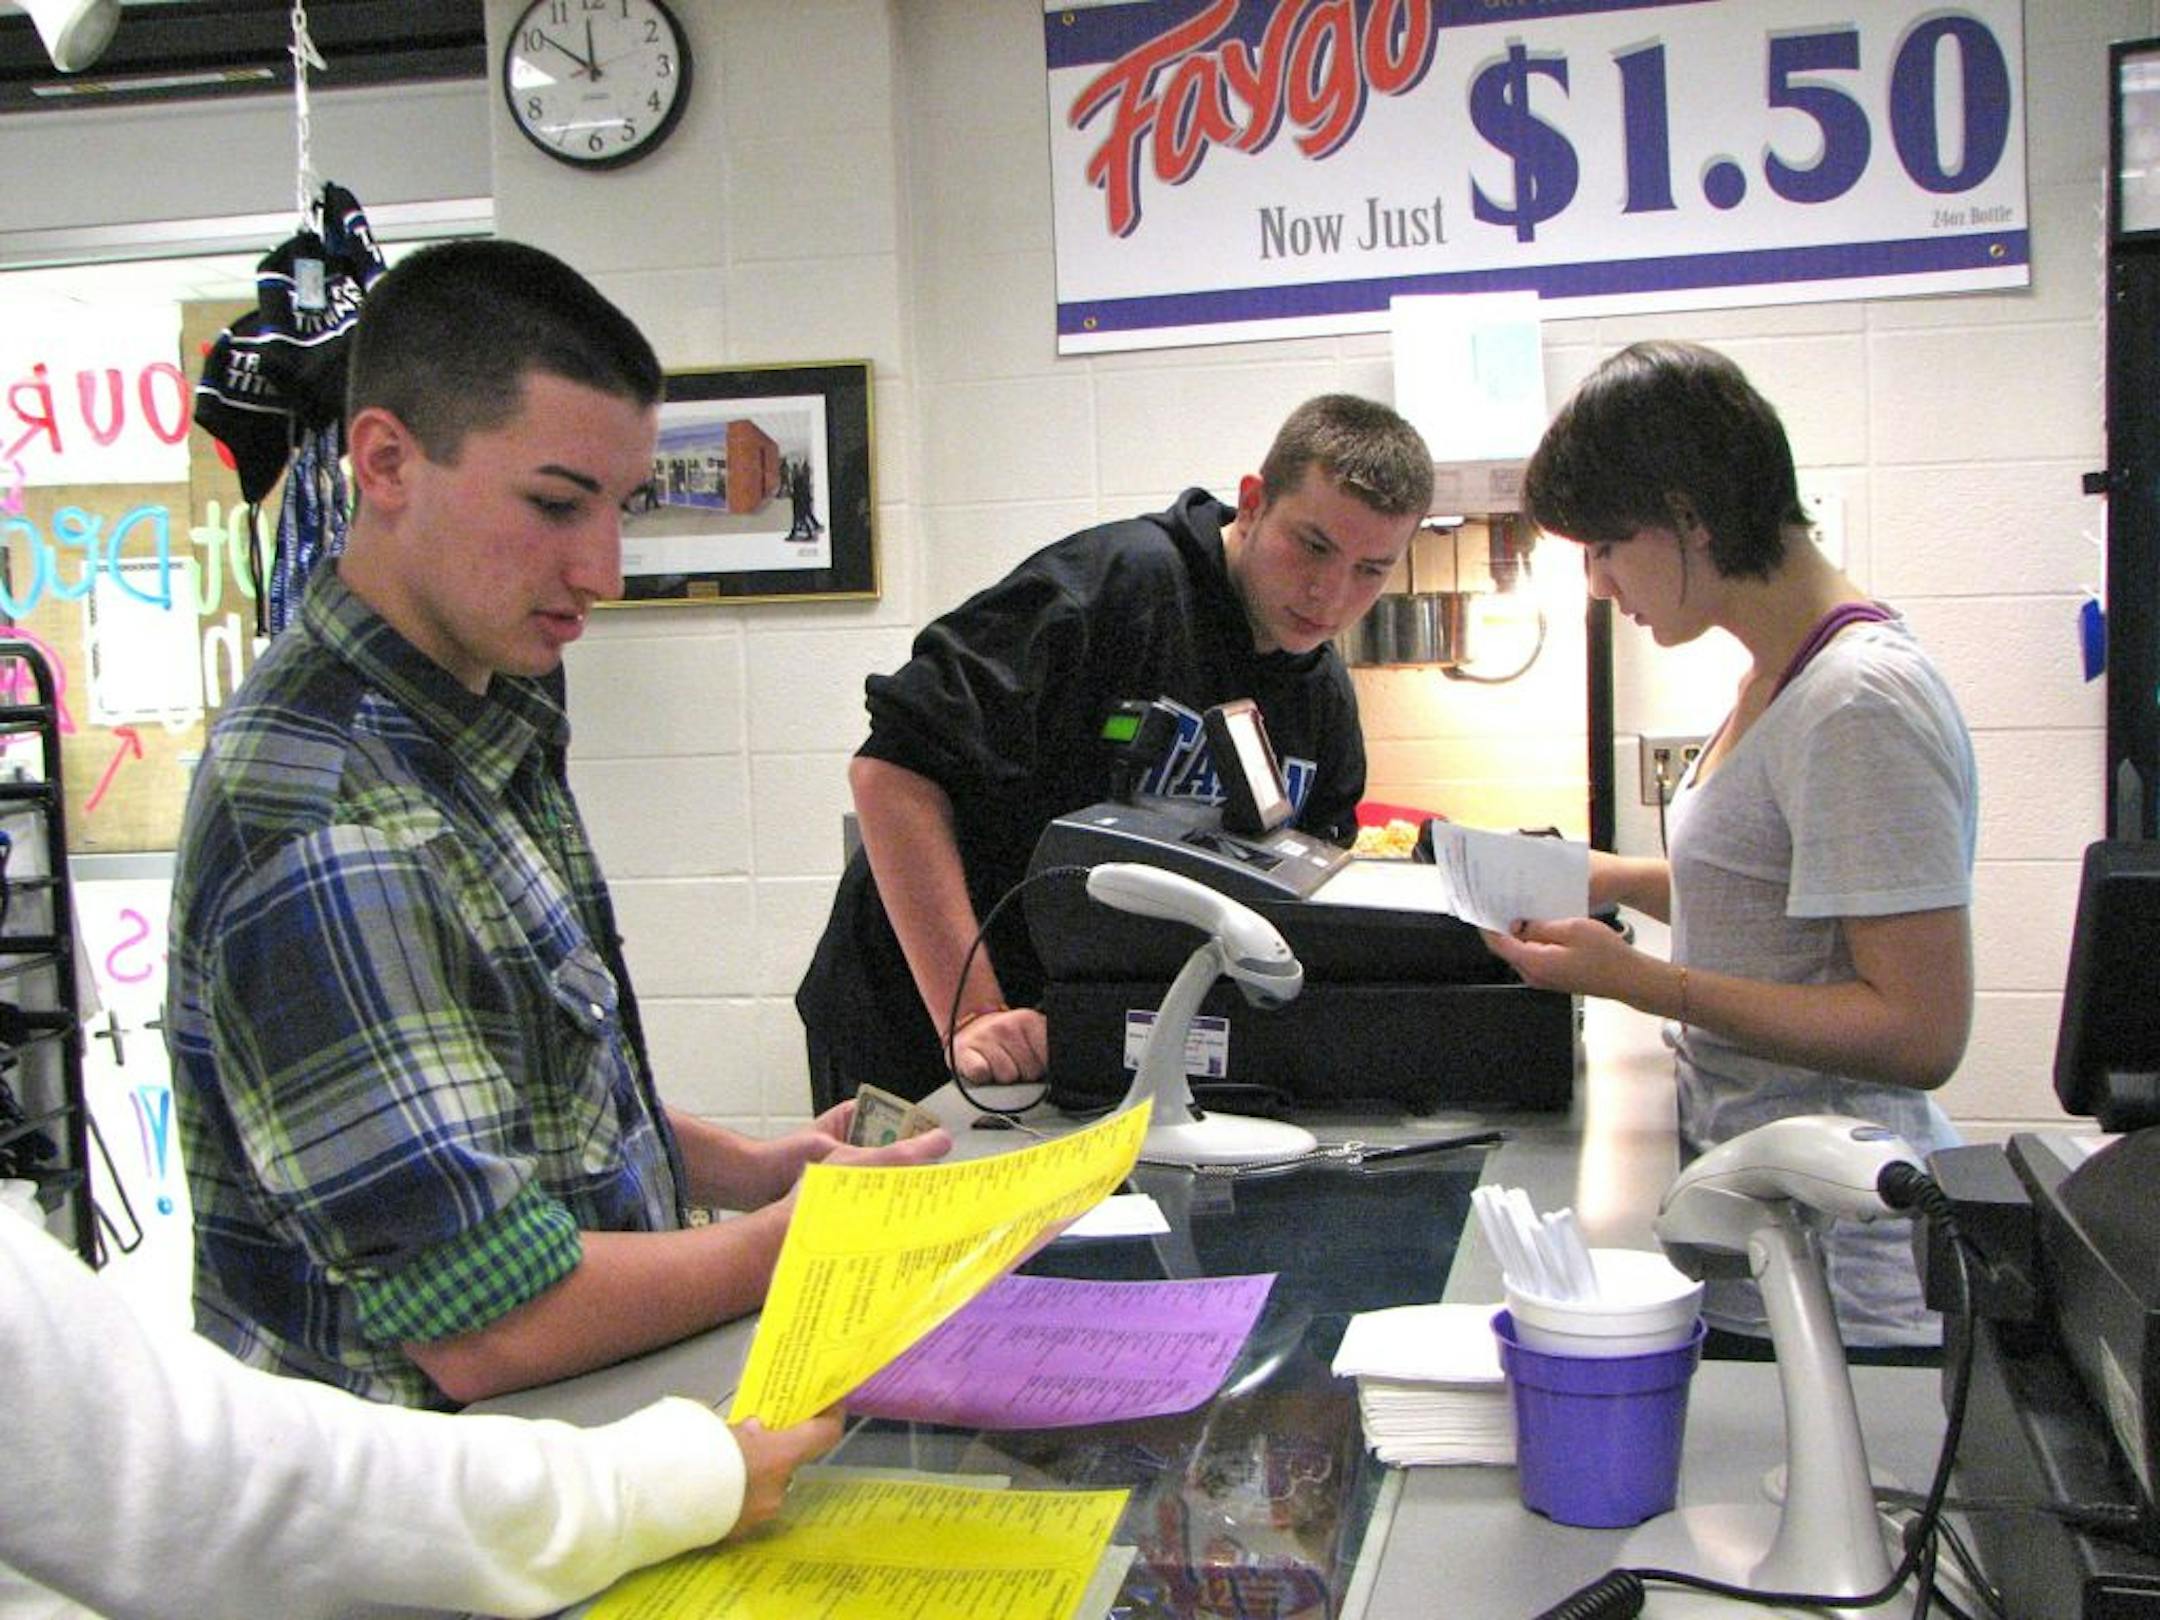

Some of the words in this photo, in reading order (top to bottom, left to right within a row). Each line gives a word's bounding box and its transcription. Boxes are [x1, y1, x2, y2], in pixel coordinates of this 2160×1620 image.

[552, 2, 567, 25] 11
[522, 29, 546, 52] 10
[643, 20, 659, 43] 2
[656, 54, 672, 78] 3
[527, 96, 543, 120] 8
[647, 90, 661, 112] 4
[621, 118, 636, 142] 5
[1068, 0, 1440, 238] Faygo
[1467, 8, 2011, 243] $1.50
[588, 132, 604, 152] 6
[1259, 205, 1345, 260] Now
[1357, 196, 1448, 251] Just
[1931, 210, 1966, 229] 24oz
[1969, 204, 2014, 227] Bottle
